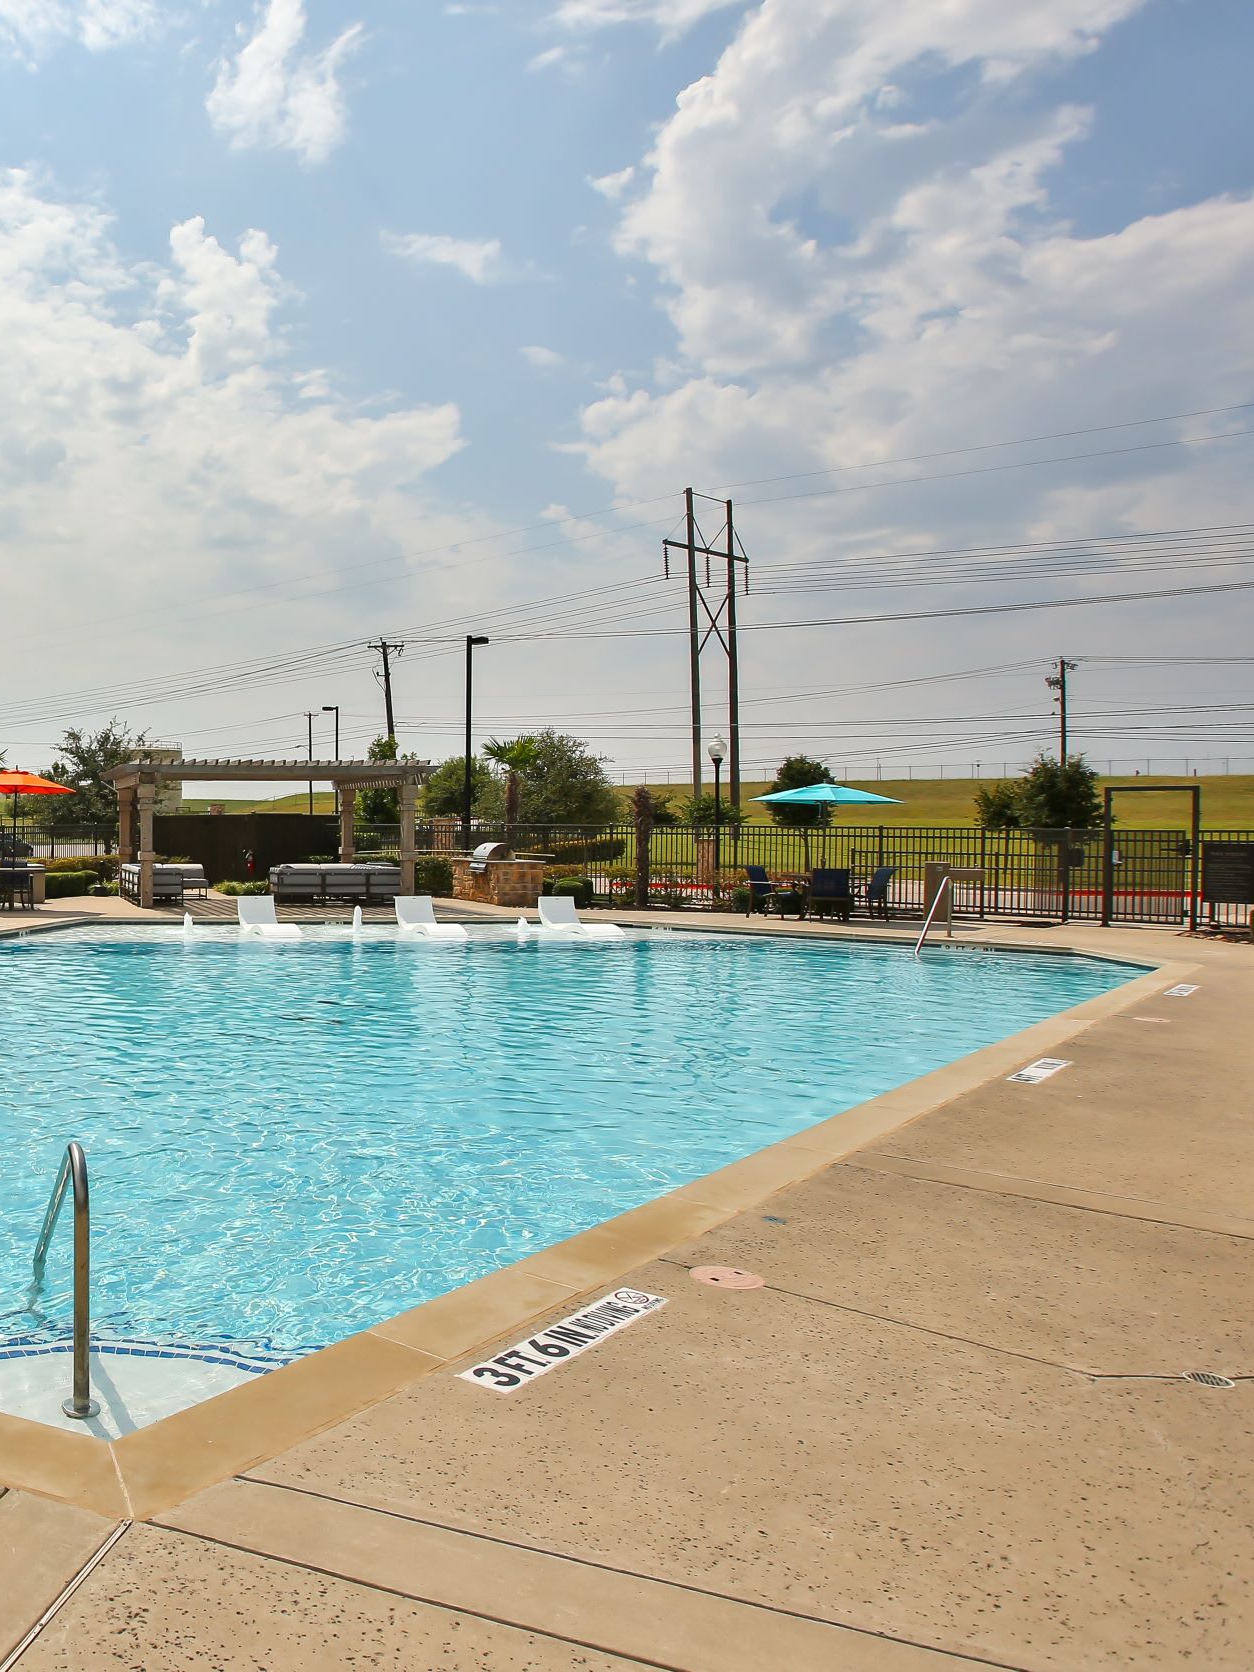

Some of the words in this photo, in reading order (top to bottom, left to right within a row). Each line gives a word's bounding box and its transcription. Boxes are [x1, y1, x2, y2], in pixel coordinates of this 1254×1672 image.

[581, 1301, 641, 1327] DIVING
[527, 1338, 571, 1358] 6
[491, 1349, 552, 1376] FT.
[472, 1367, 521, 1387] 3
